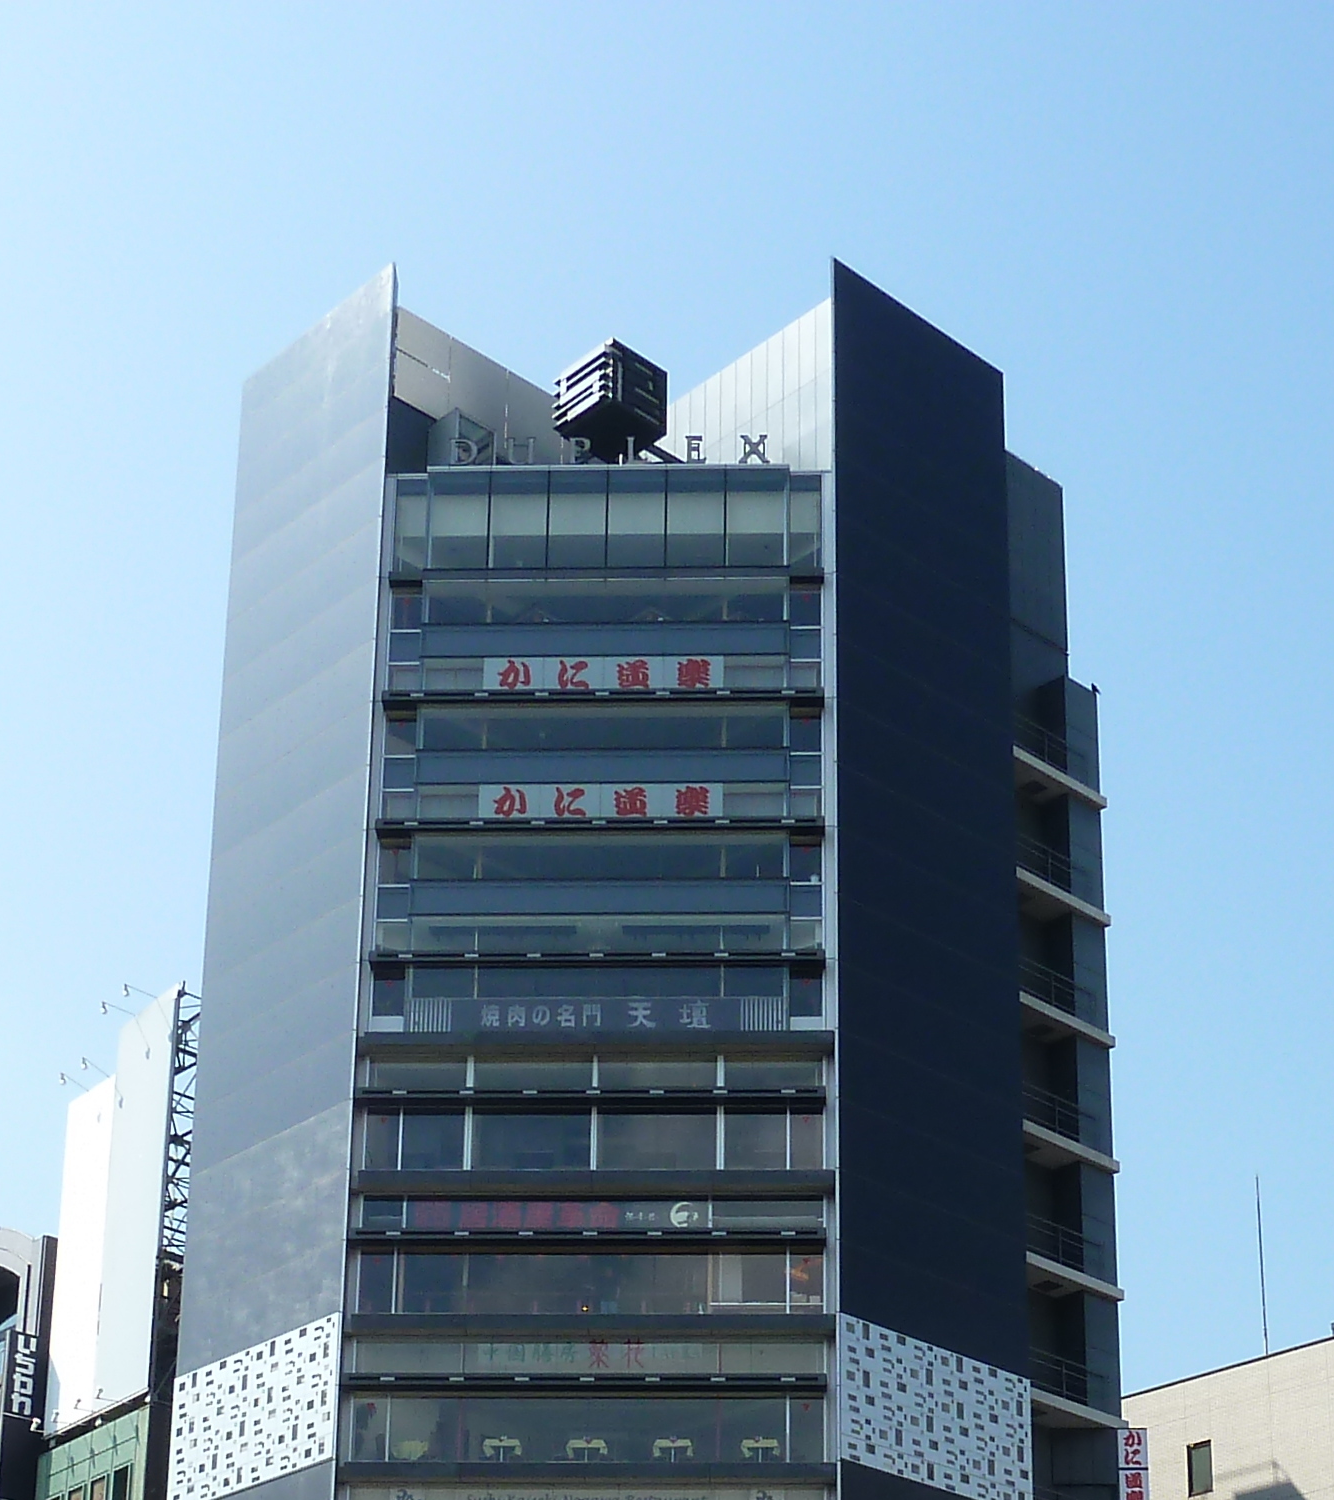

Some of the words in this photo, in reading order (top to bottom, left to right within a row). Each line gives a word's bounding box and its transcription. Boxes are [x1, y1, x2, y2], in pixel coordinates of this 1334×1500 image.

[450, 433, 770, 465] DUPLEX
[499, 659, 712, 690] かに道楽
[493, 785, 711, 818] かに道楽
[627, 1002, 712, 1029] 天壇
